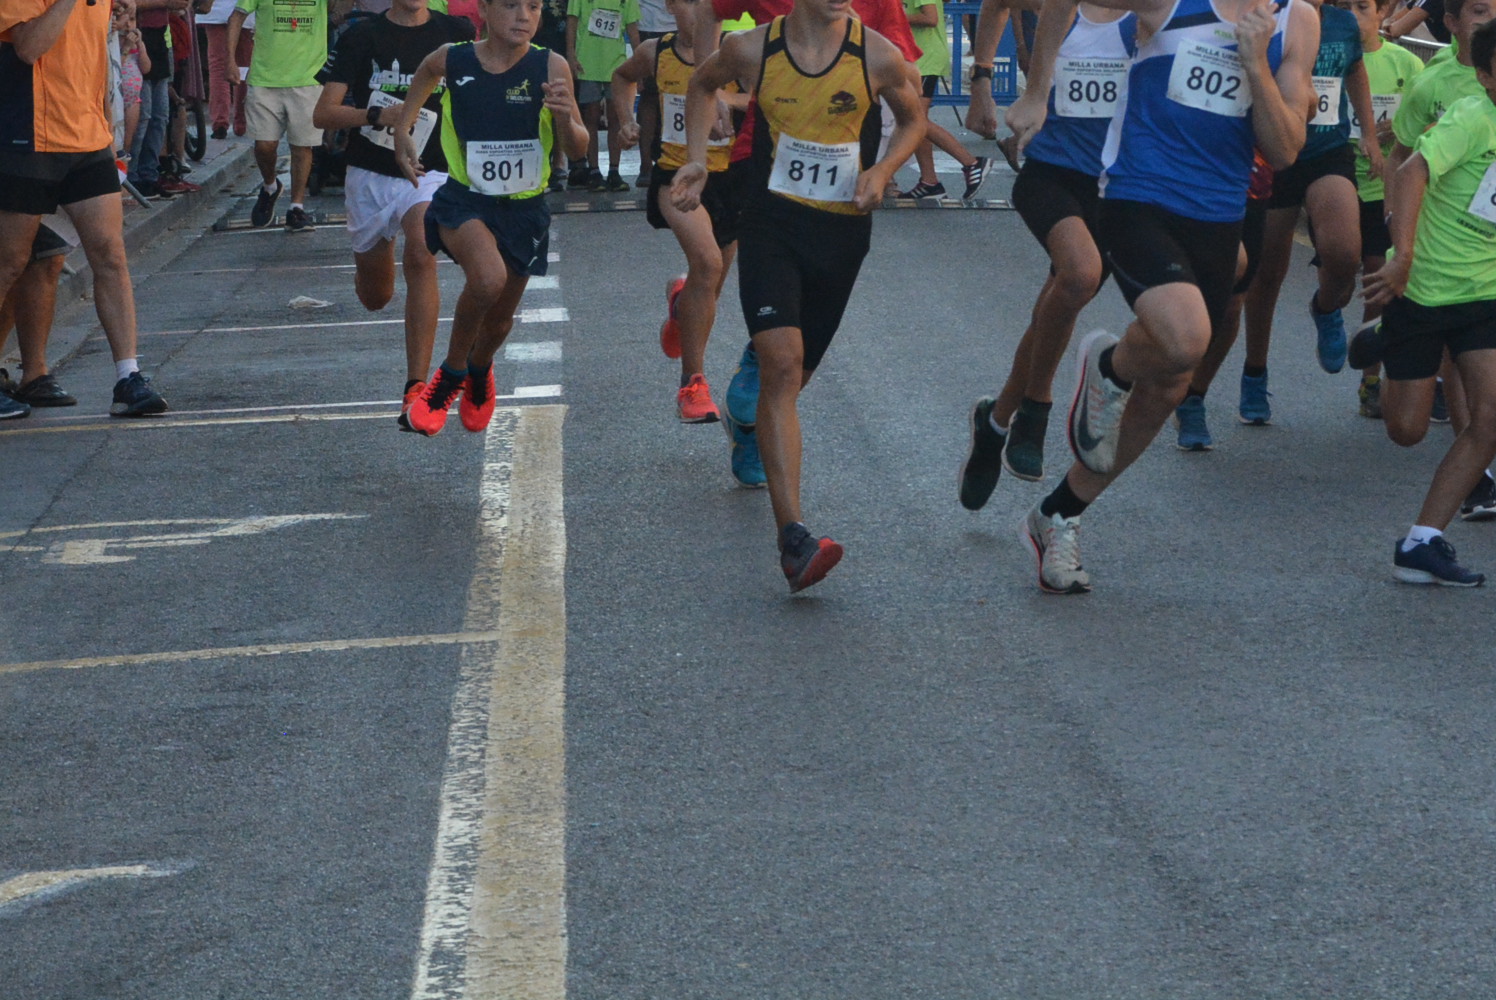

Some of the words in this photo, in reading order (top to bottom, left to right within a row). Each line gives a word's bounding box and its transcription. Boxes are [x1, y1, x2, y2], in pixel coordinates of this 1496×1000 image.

[595, 18, 616, 32] 615
[1068, 79, 1117, 103] 808
[1186, 66, 1241, 100] 802
[504, 142, 533, 150] URBANA
[481, 158, 523, 182] 801
[788, 159, 838, 186] 811
